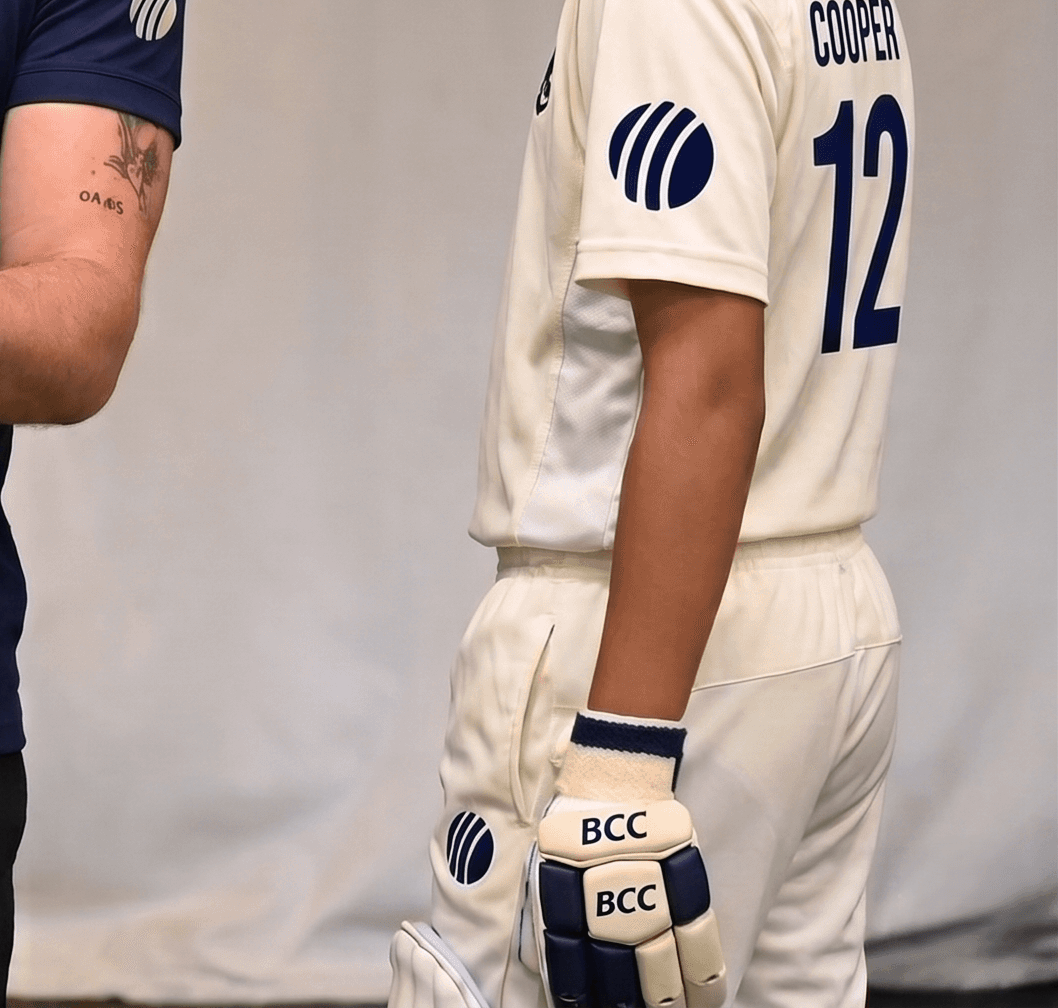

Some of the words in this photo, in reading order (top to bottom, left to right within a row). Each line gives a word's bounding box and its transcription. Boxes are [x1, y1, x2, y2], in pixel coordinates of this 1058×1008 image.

[813, 93, 909, 355] 12
[582, 812, 647, 846] BCC
[595, 884, 657, 917] BCC
